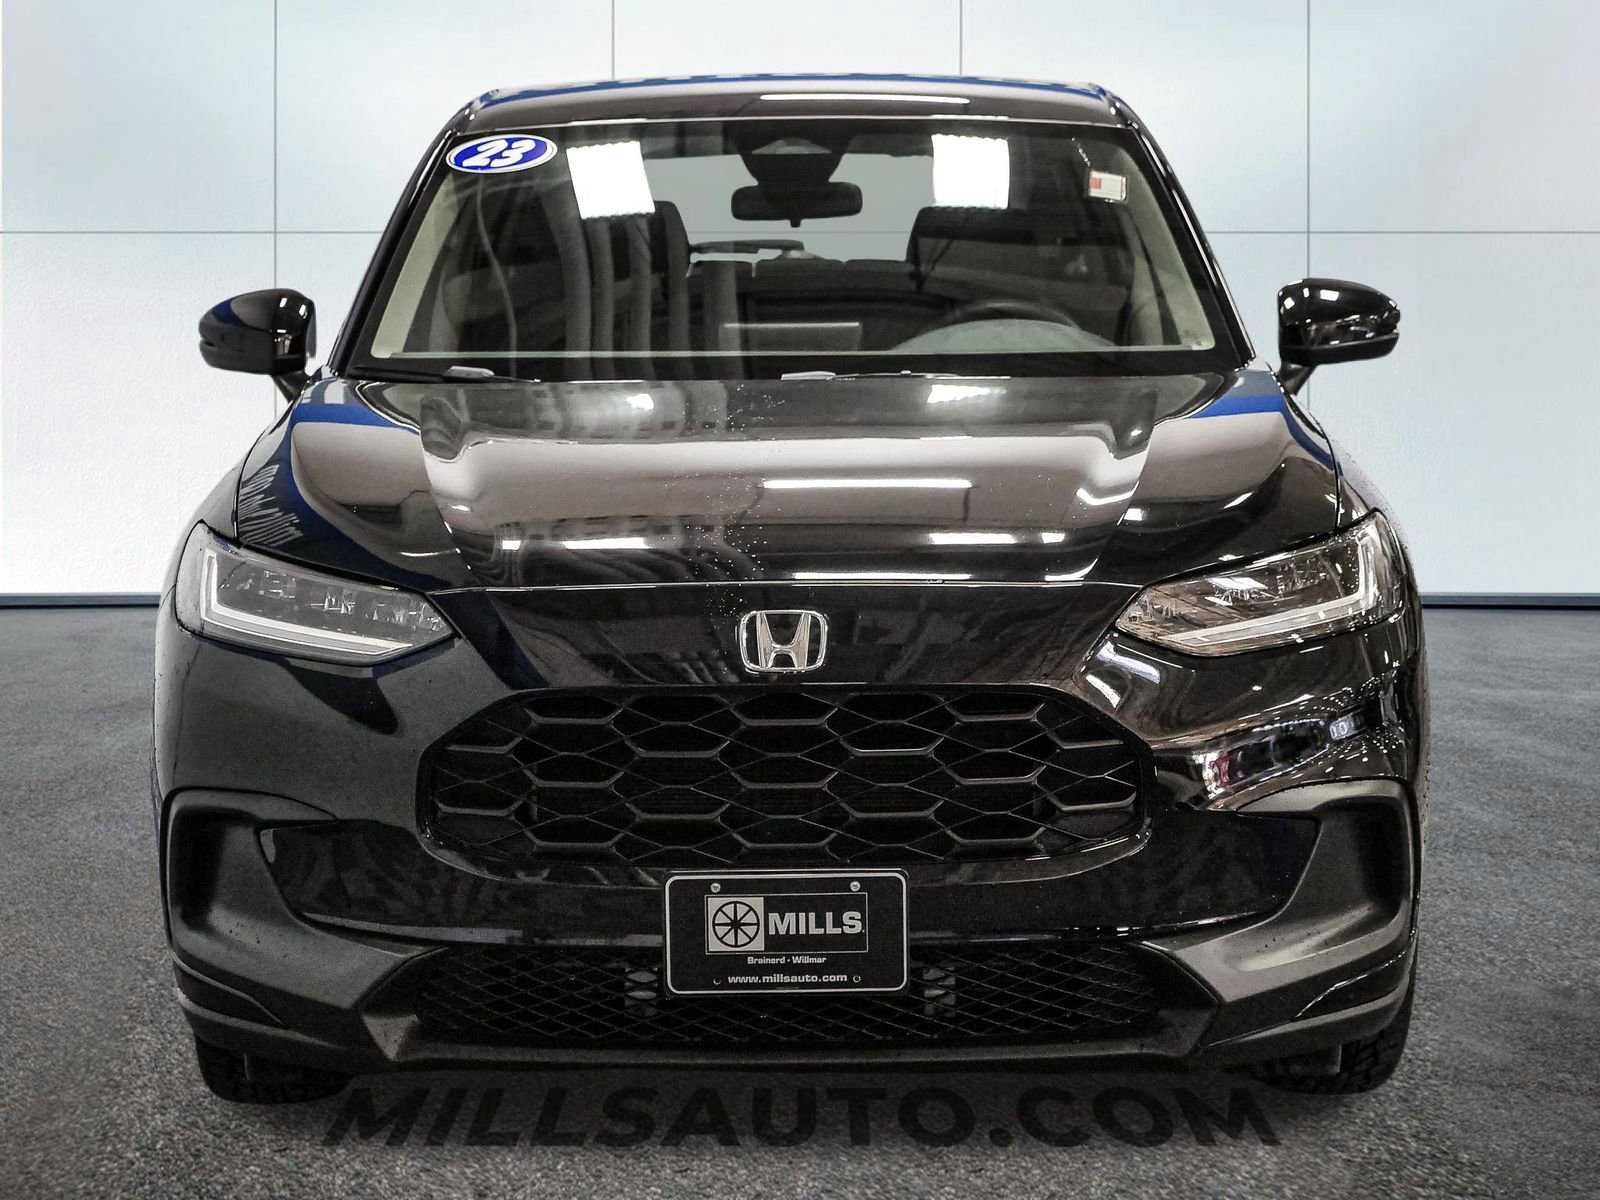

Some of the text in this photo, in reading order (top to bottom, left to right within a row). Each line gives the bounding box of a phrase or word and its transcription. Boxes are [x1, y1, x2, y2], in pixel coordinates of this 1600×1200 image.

[462, 139, 536, 168] 23
[768, 911, 862, 935] MILLS
[791, 955, 827, 964] Willmar
[727, 973, 848, 984] www.millsauto.com
